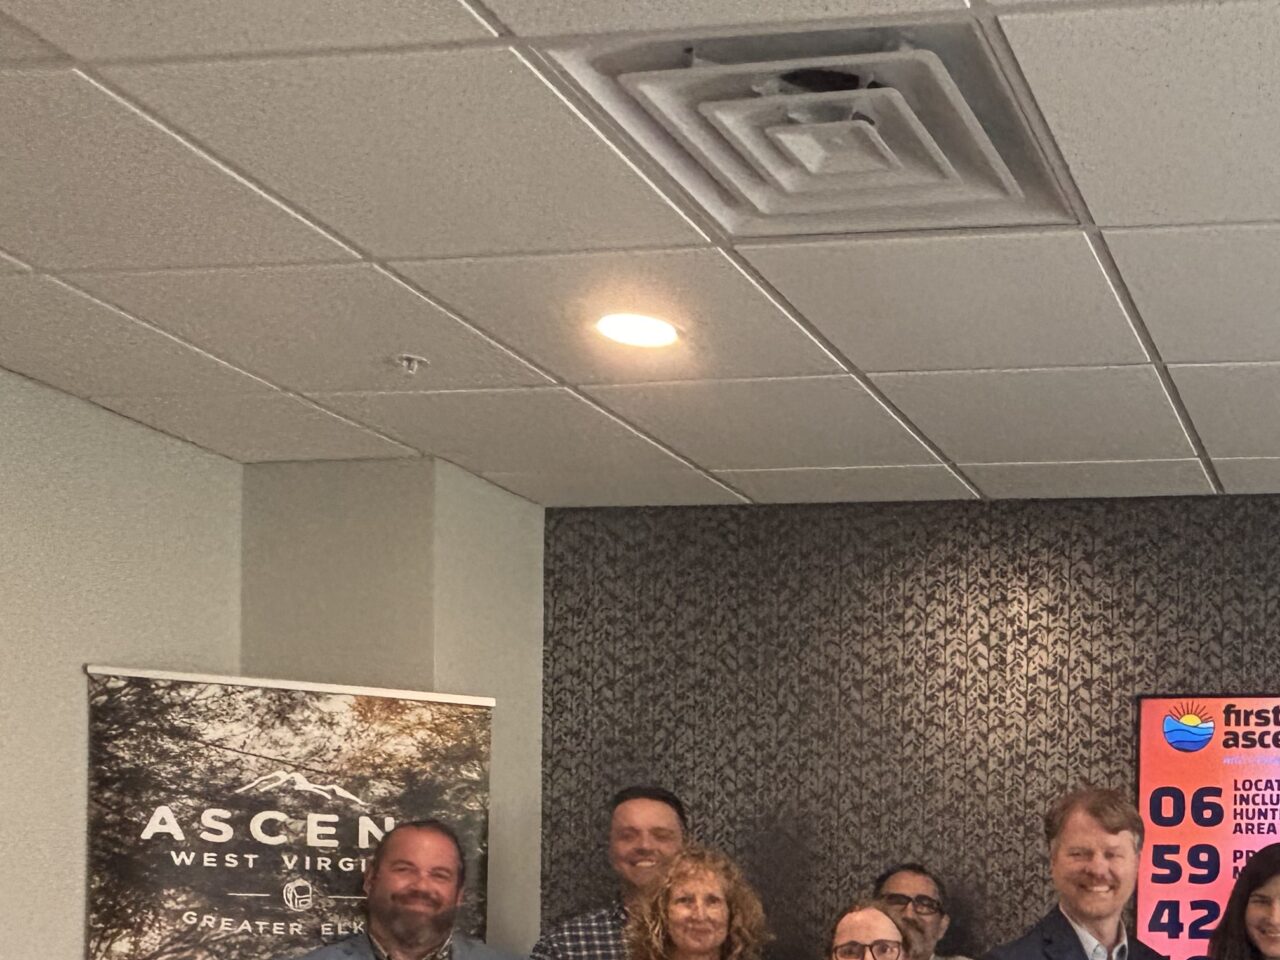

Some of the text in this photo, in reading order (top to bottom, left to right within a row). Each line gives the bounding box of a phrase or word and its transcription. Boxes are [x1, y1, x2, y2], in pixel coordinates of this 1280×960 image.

[1149, 786, 1224, 827] 06
[140, 805, 395, 849] ASCEN
[1232, 822, 1277, 835] AREA
[170, 850, 367, 873] WEST VIRGI
[1150, 844, 1221, 885] 59
[182, 910, 365, 936] GREATER ELK
[1148, 900, 1221, 940] 42
